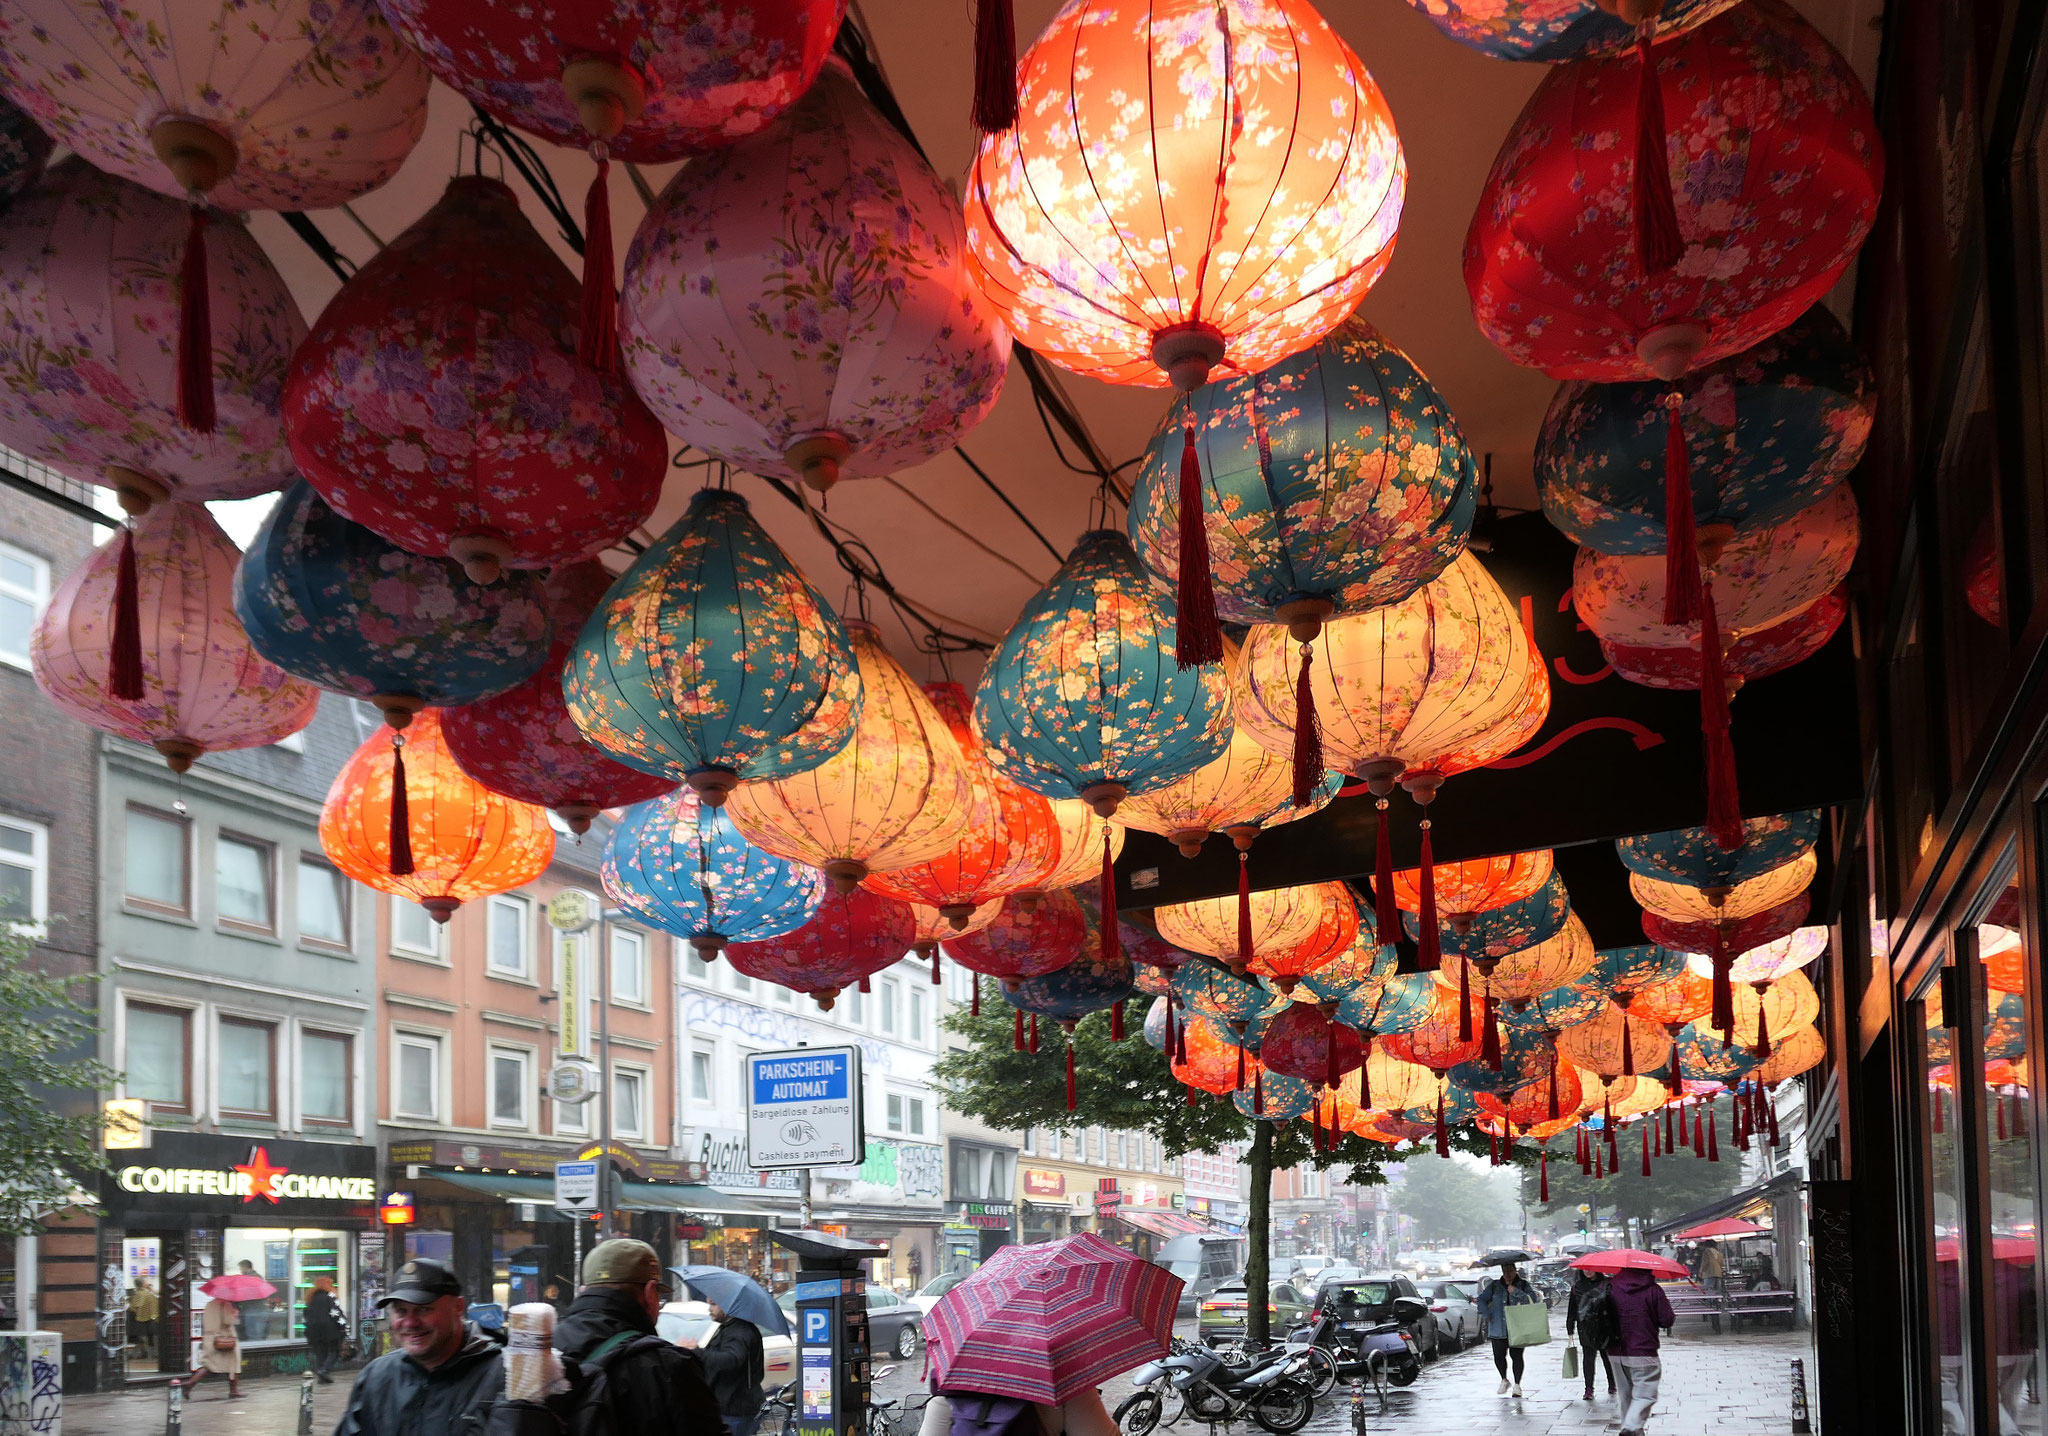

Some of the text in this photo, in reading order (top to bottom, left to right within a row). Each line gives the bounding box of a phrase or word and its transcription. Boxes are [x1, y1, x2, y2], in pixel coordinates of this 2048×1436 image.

[759, 1060, 842, 1081] PARKSCHEIN-
[772, 1080, 829, 1100] AUTOMAT
[752, 1104, 850, 1119] Bargeldlose Zahlung
[758, 1148, 844, 1161] Cashless payment
[559, 1166, 594, 1175] AUTOMAT
[118, 1165, 375, 1200] COIFFEUR SCHANZE
[970, 1216, 1008, 1228] VENEZIA
[807, 1313, 826, 1339] P
